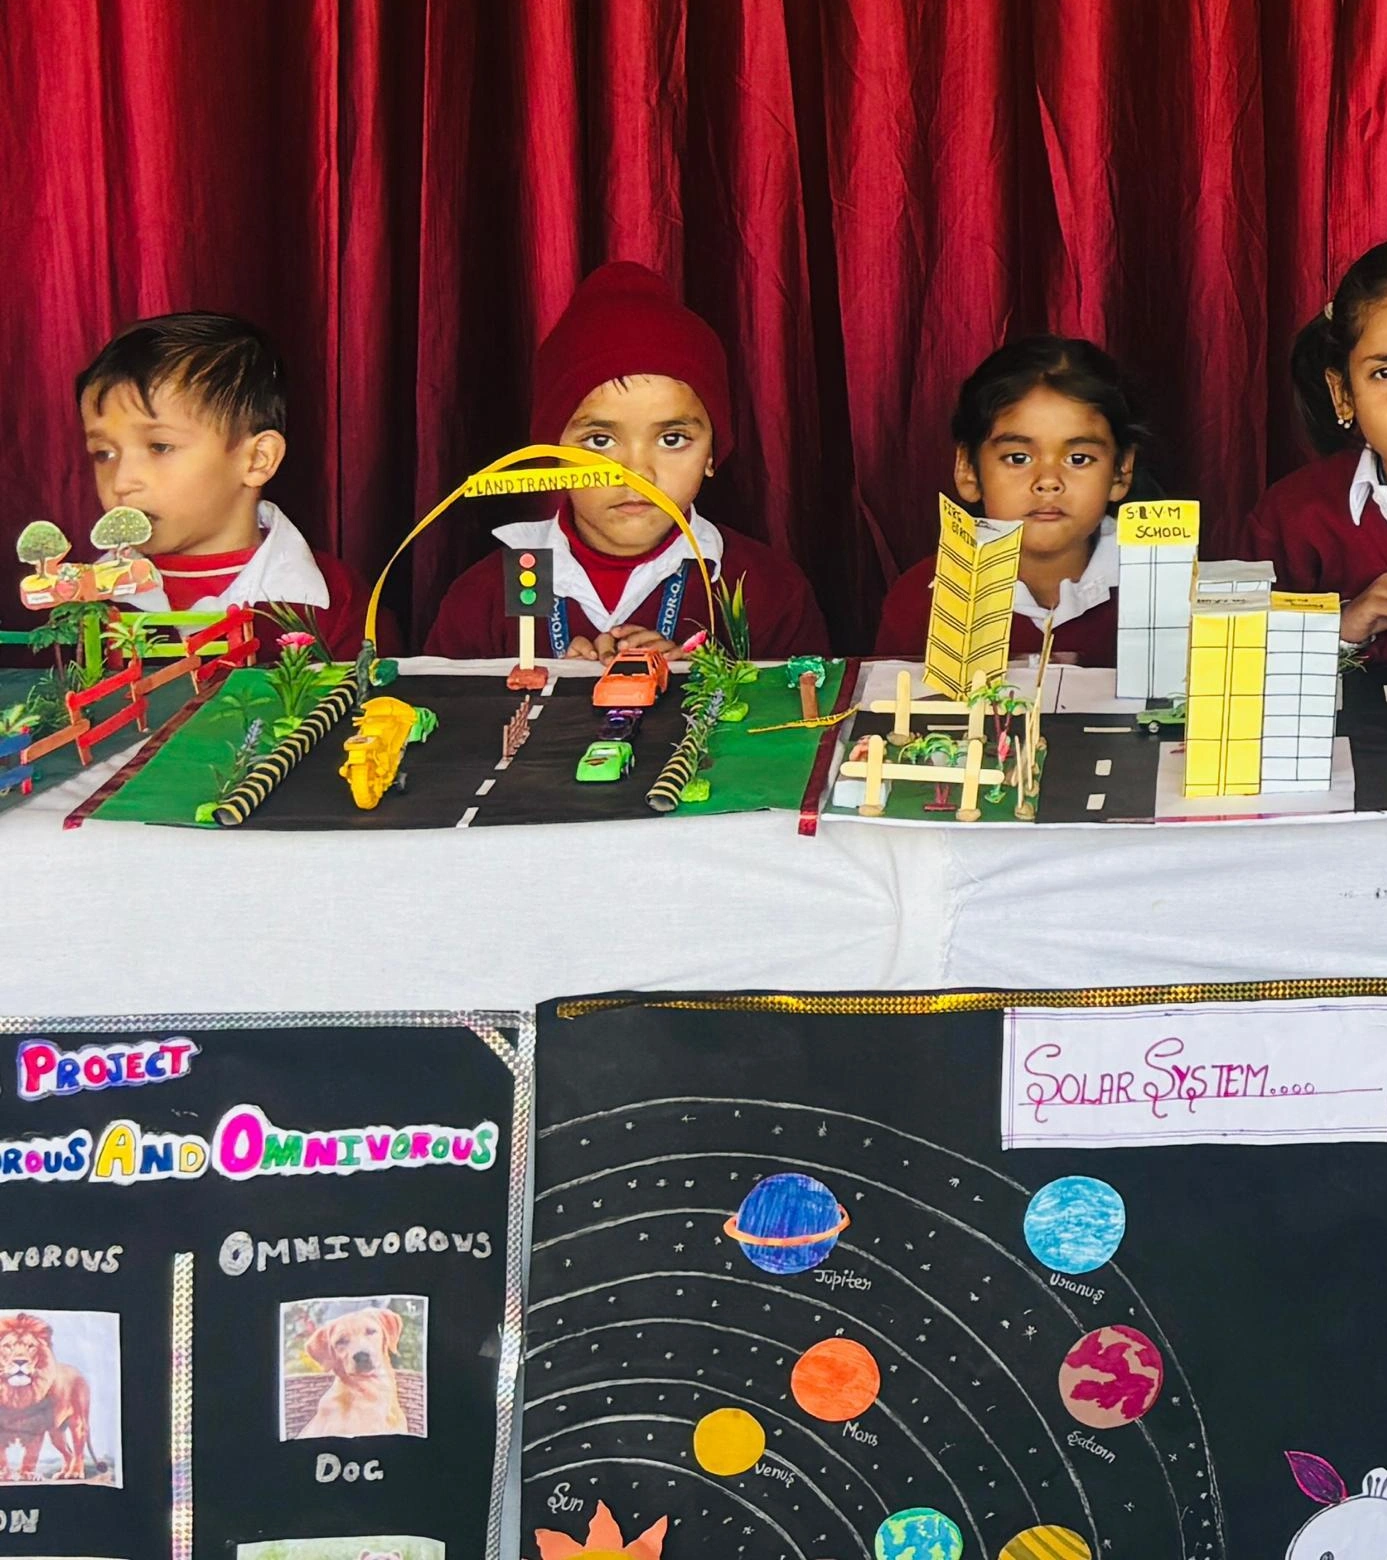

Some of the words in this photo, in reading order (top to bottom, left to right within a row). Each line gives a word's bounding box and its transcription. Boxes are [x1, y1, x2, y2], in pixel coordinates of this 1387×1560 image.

[1135, 525, 1191, 539] SCHOOL
[21, 1041, 194, 1093] PROJECT
[1024, 1043, 1137, 1123] SOLAR
[0, 1136, 87, 1176] ROUS
[95, 1123, 207, 1178] AND
[219, 1112, 494, 1174] OMNIVOROUS
[814, 1268, 873, 1293] Jupiter
[842, 1420, 880, 1448] Mars
[315, 1453, 385, 1484] DOG
[754, 1462, 797, 1490] Venus
[547, 1481, 585, 1516] Sun
